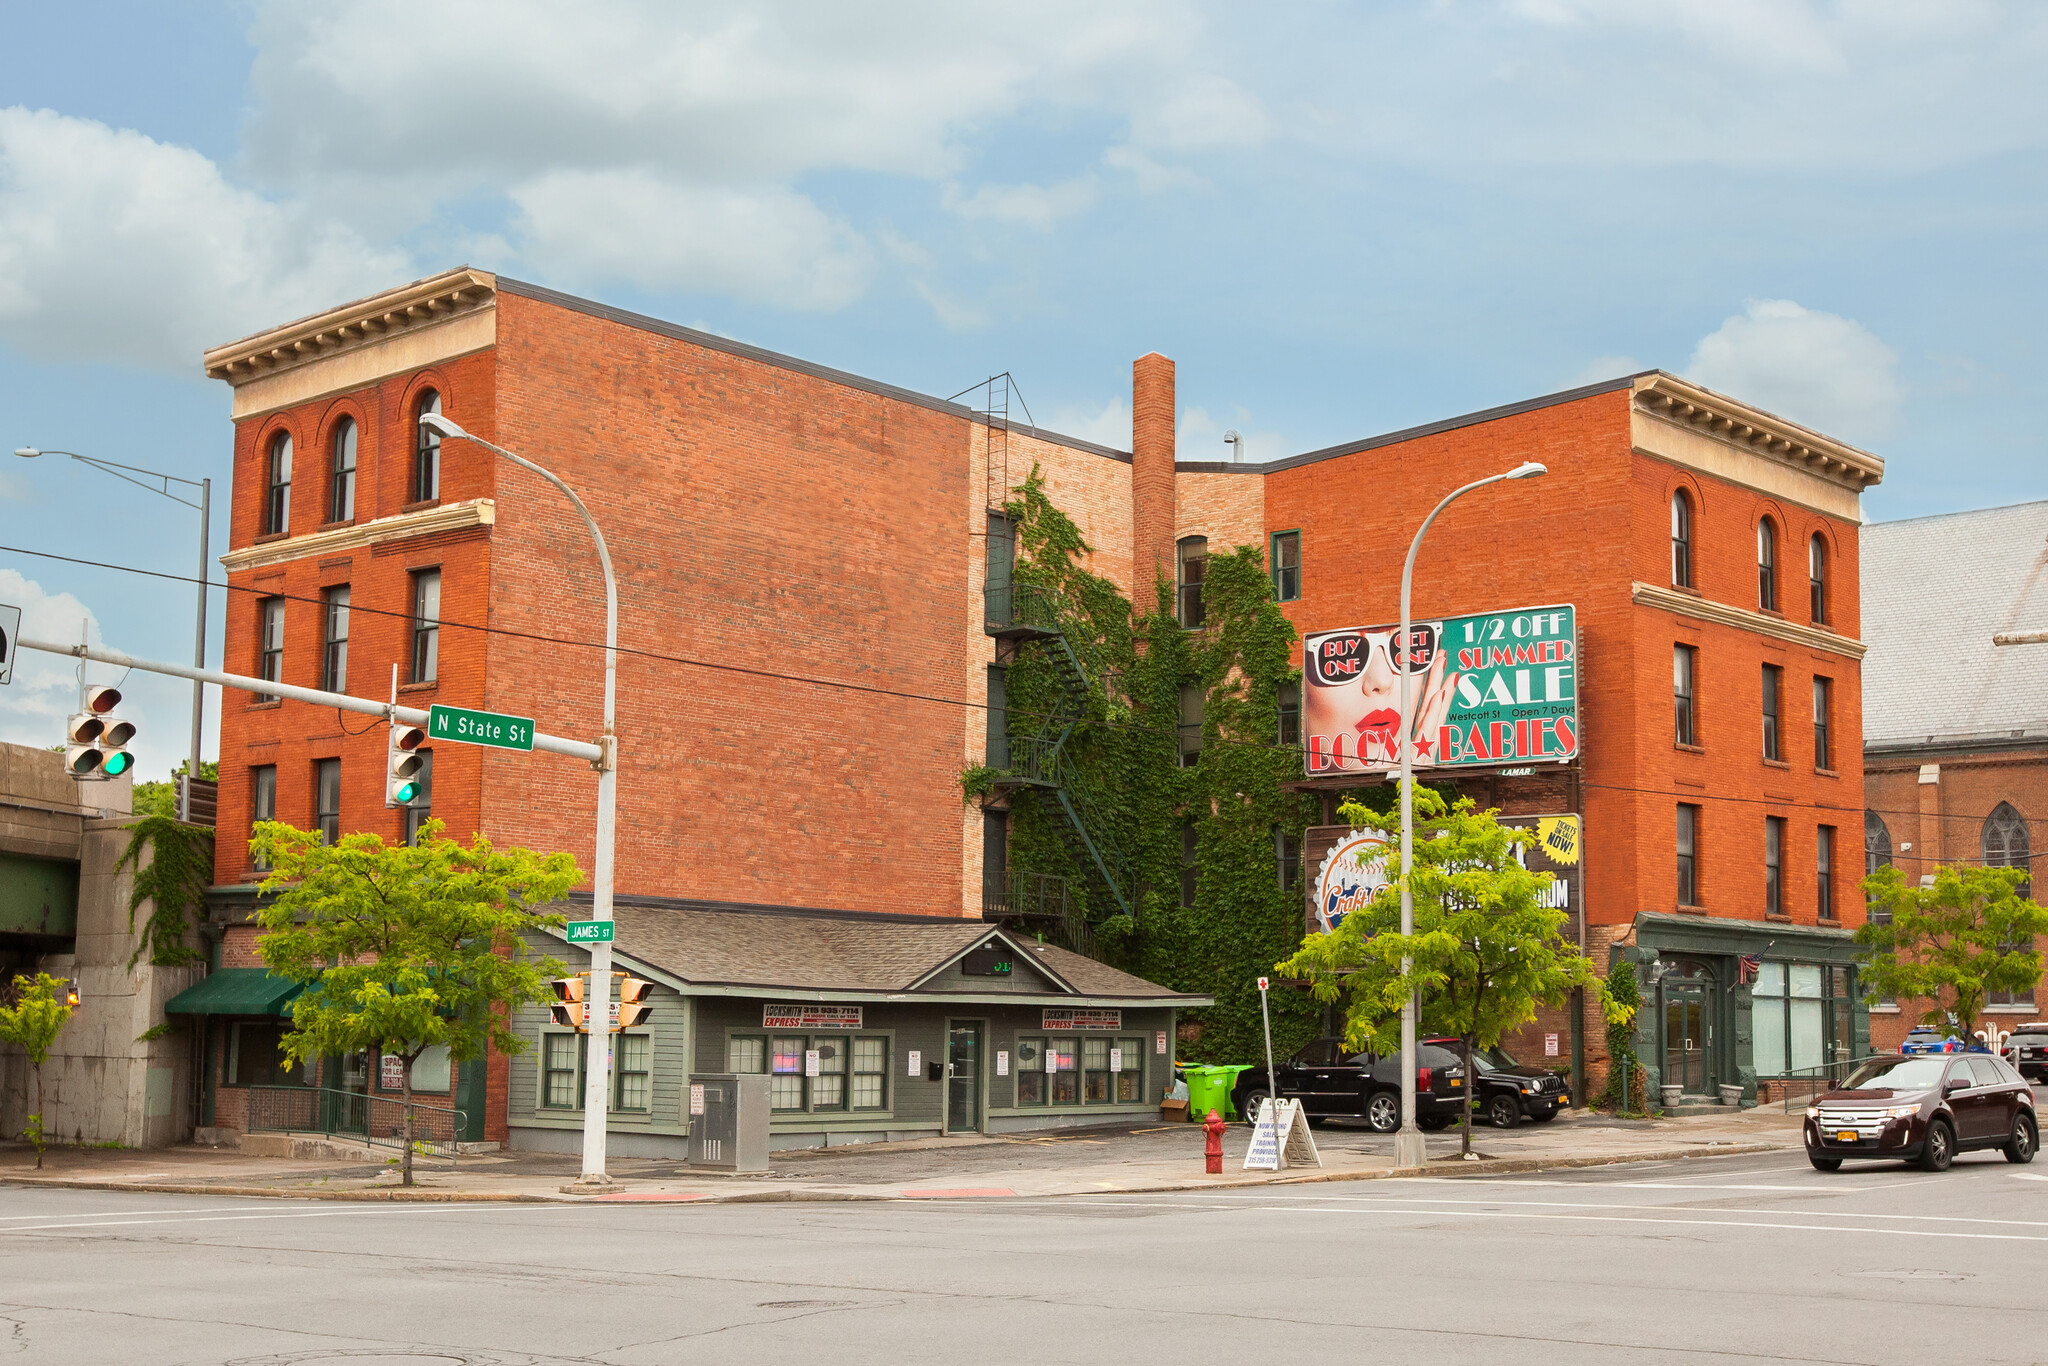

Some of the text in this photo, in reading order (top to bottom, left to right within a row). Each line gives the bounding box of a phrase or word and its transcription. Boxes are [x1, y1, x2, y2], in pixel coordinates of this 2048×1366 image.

[1462, 613, 1567, 645] 1/2 OFF
[1324, 638, 1361, 658] BUY
[1457, 639, 1574, 671] SUMMER
[1324, 657, 1361, 677] ONE
[1457, 665, 1574, 709] SALE
[1448, 711, 1490, 722] Westcott
[1492, 710, 1501, 720] St
[1511, 708, 1540, 718] Open
[1542, 706, 1549, 715] 7
[438, 714, 526, 743] N State St
[1439, 715, 1577, 762] BABIES
[1502, 768, 1531, 776] LAMAR
[1557, 819, 1577, 835] TICKETS
[1546, 831, 1574, 856] NOW!
[1561, 830, 1574, 842] SALE
[571, 925, 610, 939] JAMES ST
[765, 1005, 803, 1017] LOCKSMITH
[803, 1006, 819, 1014] 315
[764, 1017, 801, 1027] EXPRESS
[1043, 1020, 1072, 1029] EXPRESS
[384, 1057, 404, 1067] SPAC
[393, 1067, 404, 1076] LEA
[1270, 1122, 1287, 1130] HING
